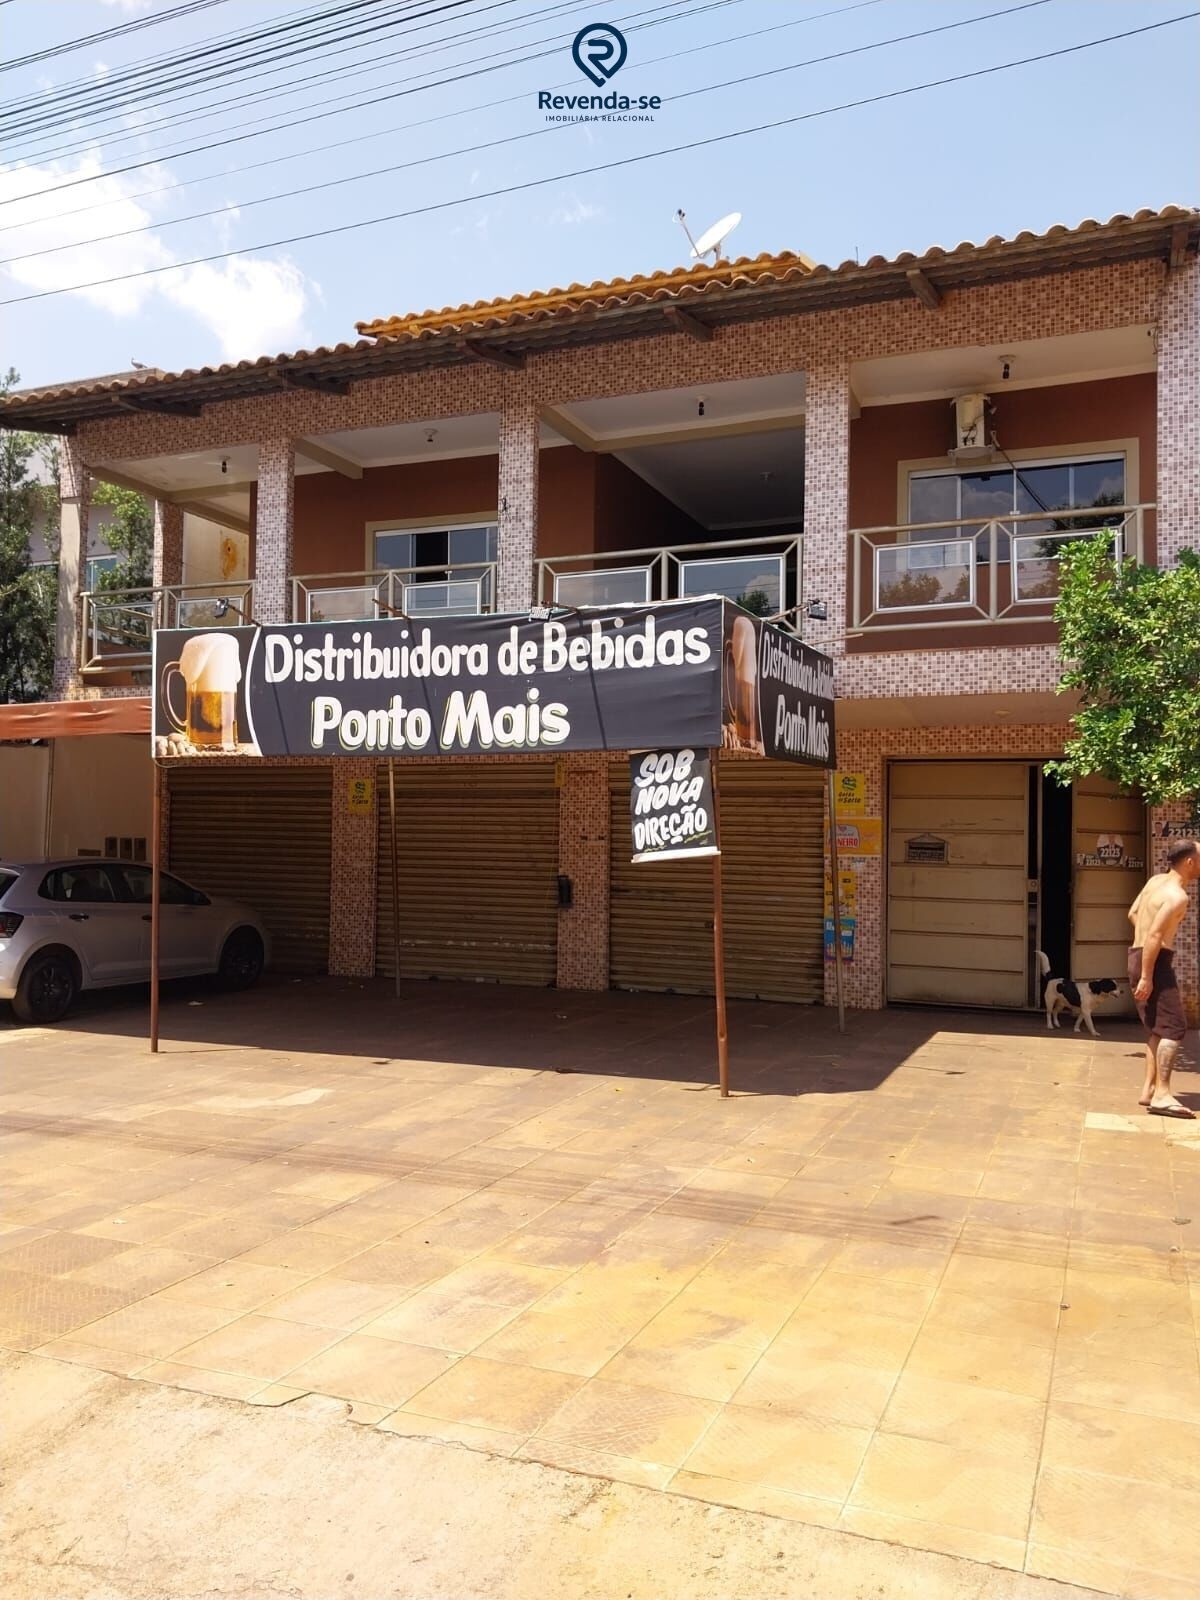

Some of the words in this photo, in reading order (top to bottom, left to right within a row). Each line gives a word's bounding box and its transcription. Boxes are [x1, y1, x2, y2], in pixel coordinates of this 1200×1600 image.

[264, 627, 489, 683] Distribuidora
[497, 625, 537, 676] de
[543, 614, 711, 672] Bebidas
[311, 695, 432, 750] Ponto
[440, 687, 571, 749] Mais
[774, 694, 807, 754] Ponto
[807, 705, 829, 761] Mais
[634, 749, 695, 788] SOB
[635, 776, 704, 815] NOVA
[634, 803, 708, 850] DIREÇÃO
[828, 837, 859, 847] NEIRO
[1169, 828, 1200, 838] 22123
[1100, 847, 1121, 858] 22123
